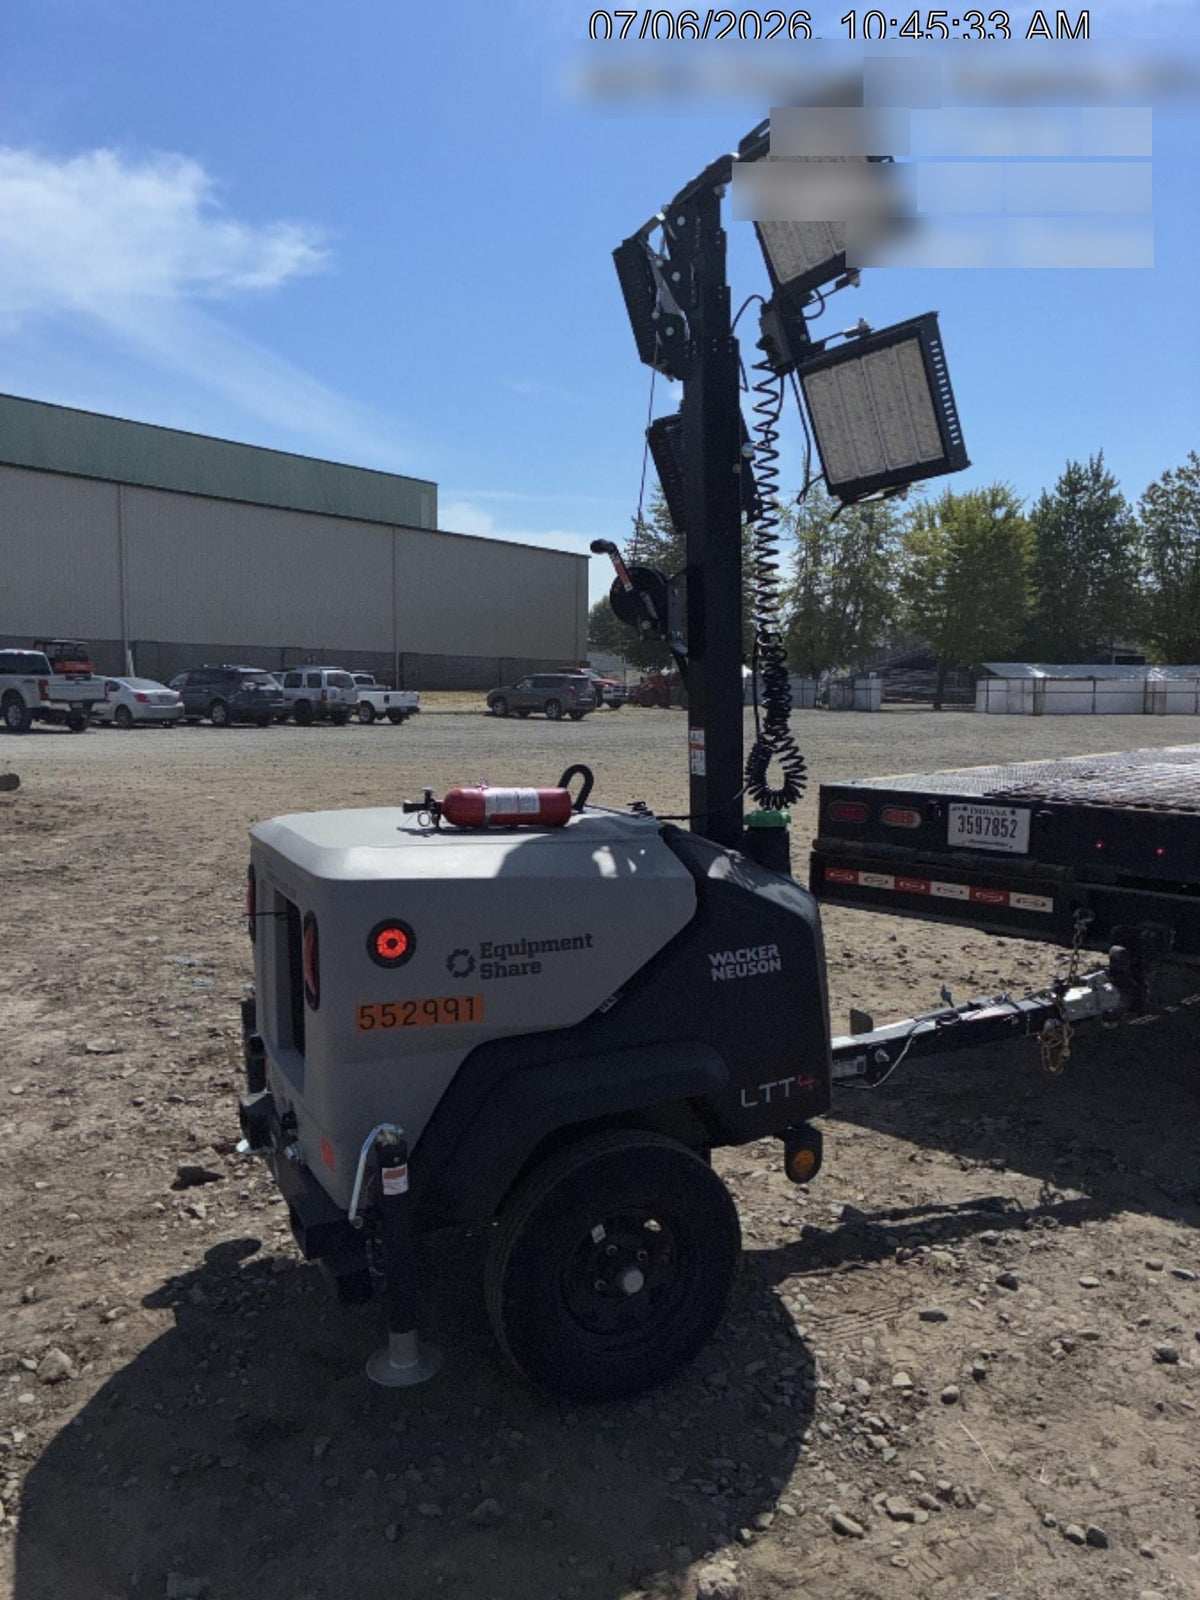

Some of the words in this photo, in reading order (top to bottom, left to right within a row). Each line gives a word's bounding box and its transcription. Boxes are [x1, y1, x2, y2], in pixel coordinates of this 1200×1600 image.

[957, 814, 1017, 838] 3597852
[479, 932, 593, 961] Equipment
[707, 943, 781, 967] WACKER
[479, 958, 542, 980] Share
[710, 957, 782, 982] NEUSON
[358, 996, 476, 1031] 552991
